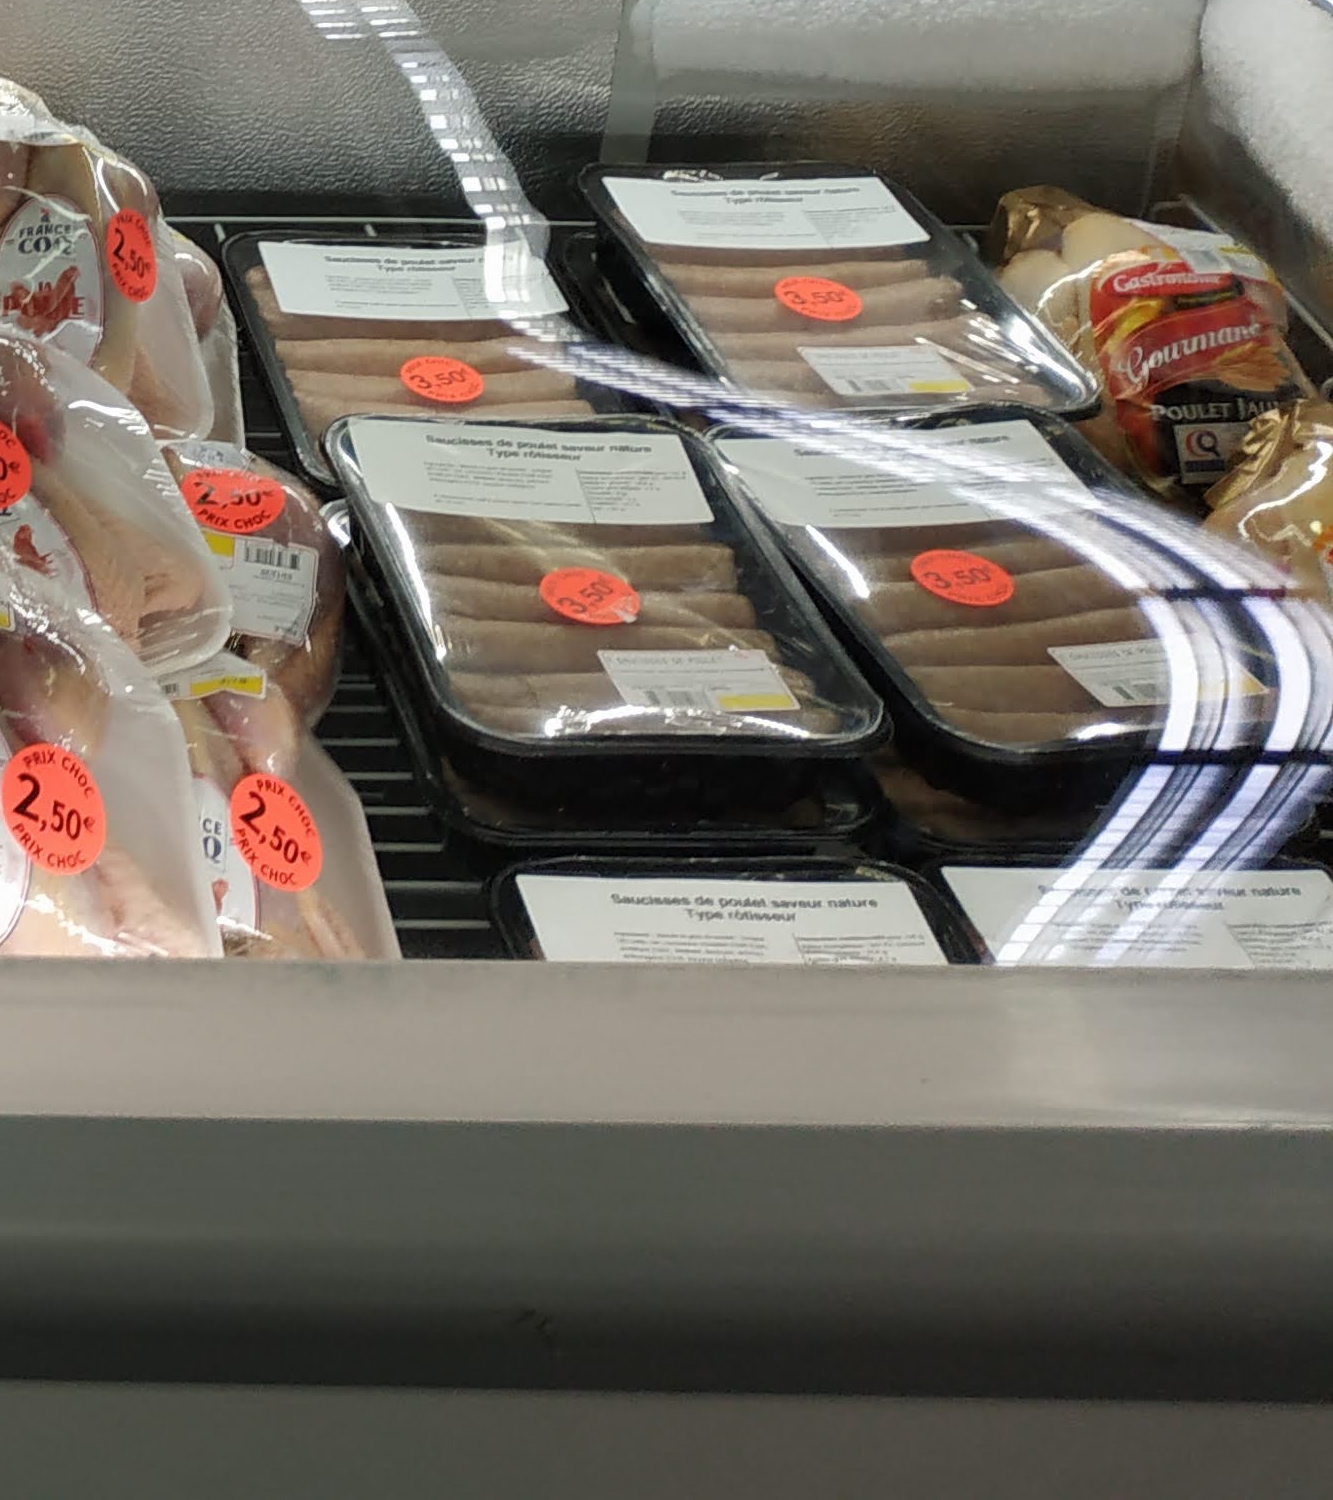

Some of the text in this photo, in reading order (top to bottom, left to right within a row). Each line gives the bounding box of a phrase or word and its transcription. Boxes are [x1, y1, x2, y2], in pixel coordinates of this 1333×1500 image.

[18, 236, 72, 256] COQ
[19, 224, 72, 239] FRANCE
[113, 227, 151, 280] 2,50€
[1150, 402, 1230, 421] POULET
[199, 508, 272, 530] PRIX CHOC
[24, 749, 95, 800] PRIX CHOC
[12, 773, 96, 841] 2,50€
[238, 789, 311, 866] 2,50€
[256, 778, 317, 840] PRIX CHOC
[12, 822, 87, 869] PRIX CHOC
[236, 826, 257, 868] PRIX
[259, 862, 298, 887] CHOC
